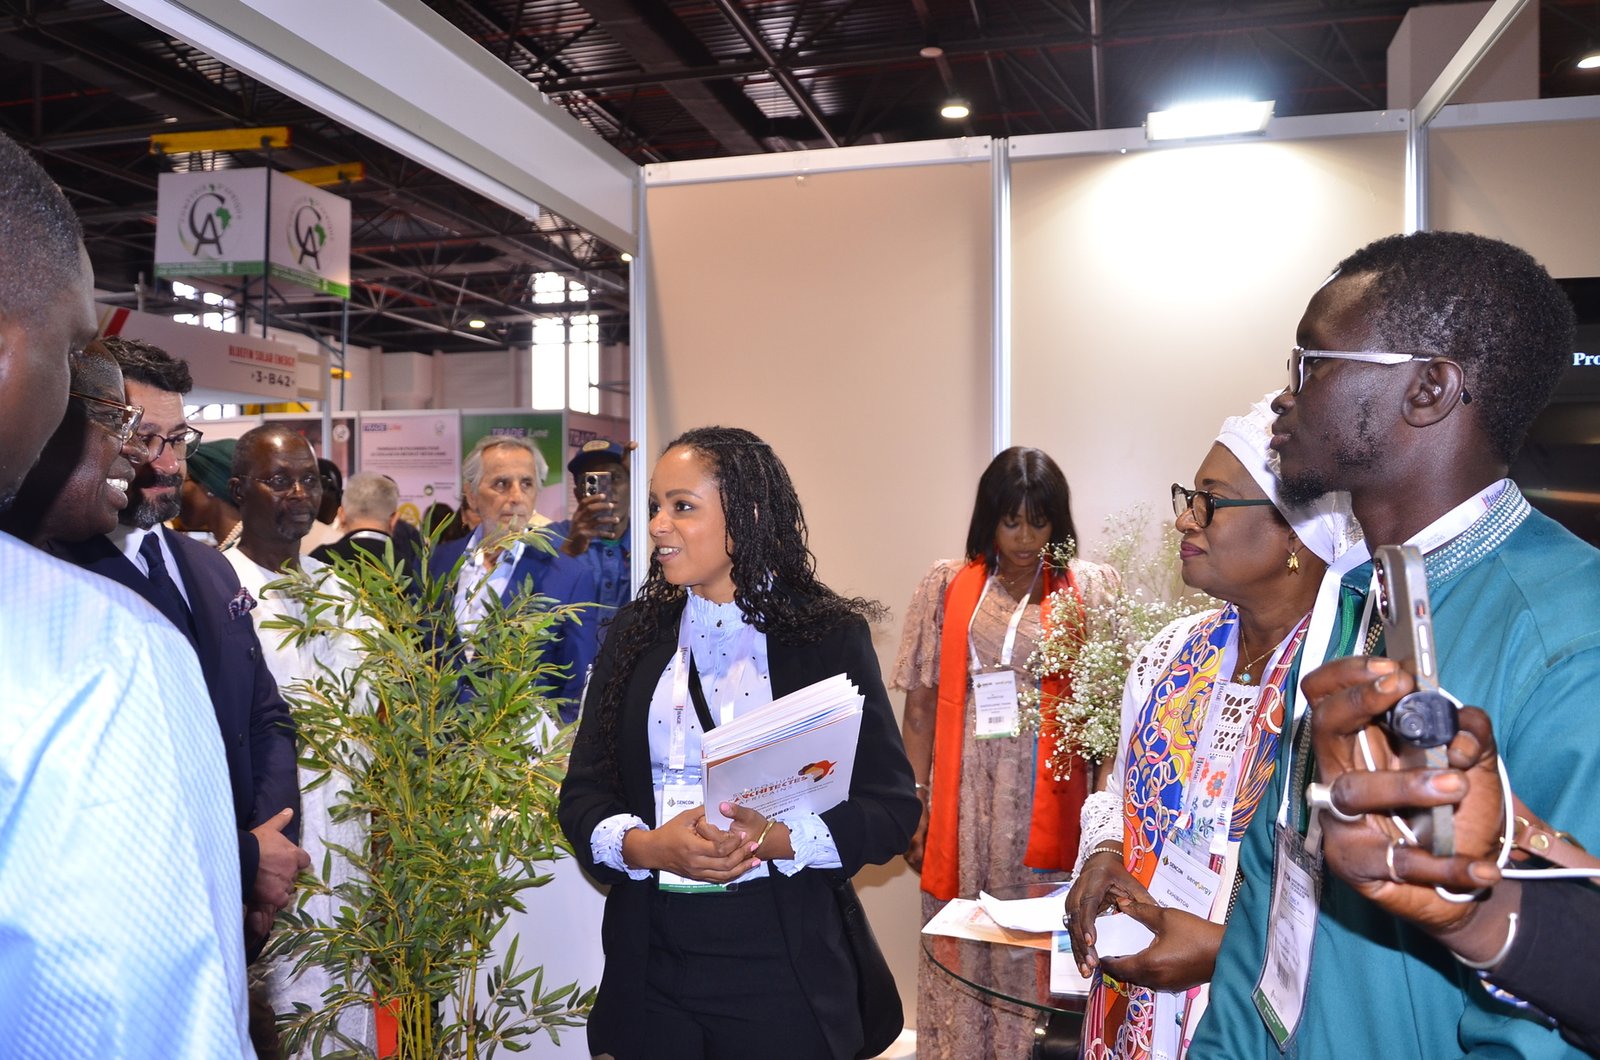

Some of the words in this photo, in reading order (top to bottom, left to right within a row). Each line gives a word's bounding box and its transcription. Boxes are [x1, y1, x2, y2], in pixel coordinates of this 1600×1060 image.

[734, 776, 808, 803] ARCHITECTES
[1169, 861, 1183, 875] SENCON
[1166, 889, 1189, 908] EXHIBITOR
